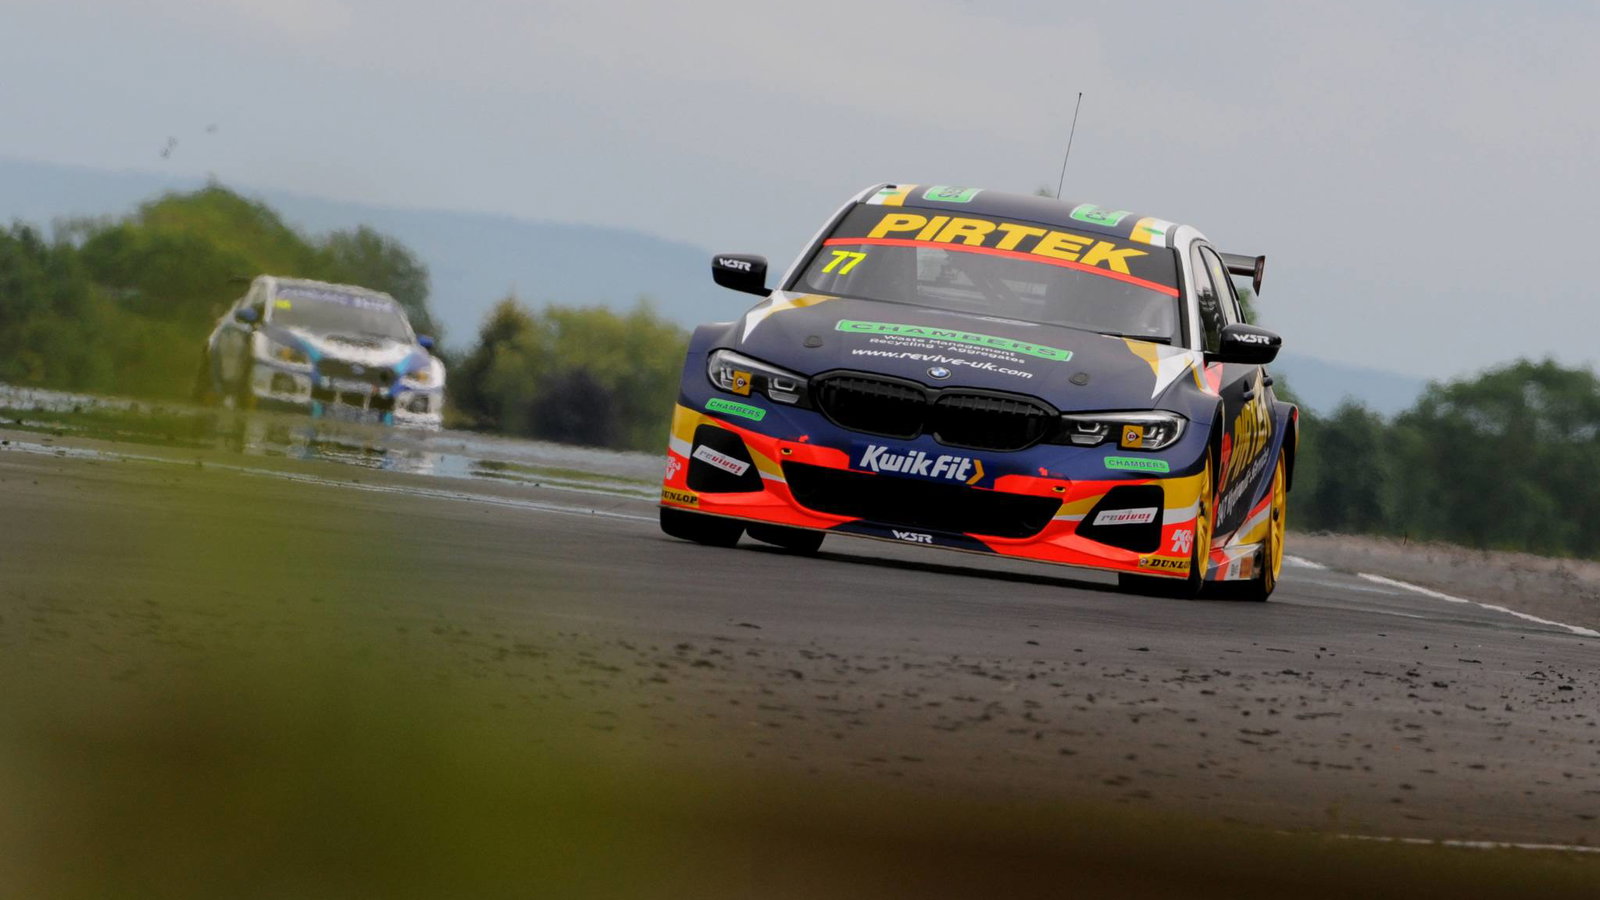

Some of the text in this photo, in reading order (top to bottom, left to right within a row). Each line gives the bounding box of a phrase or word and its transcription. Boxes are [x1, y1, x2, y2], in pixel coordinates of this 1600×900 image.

[867, 213, 1149, 275] PIRTEK
[719, 257, 752, 272] WSR
[821, 250, 867, 275] 77
[851, 323, 1056, 356] CHAMBERS
[884, 335, 1016, 357] Waste Management
[1233, 333, 1270, 345] WSR
[869, 338, 934, 349] Recycling
[947, 346, 1025, 364] Aggregates
[851, 349, 1034, 379] www.revive-uk.com
[710, 401, 761, 418] CHAMBERS
[1108, 459, 1166, 469] CHAMBERS
[892, 530, 933, 543] WSR
